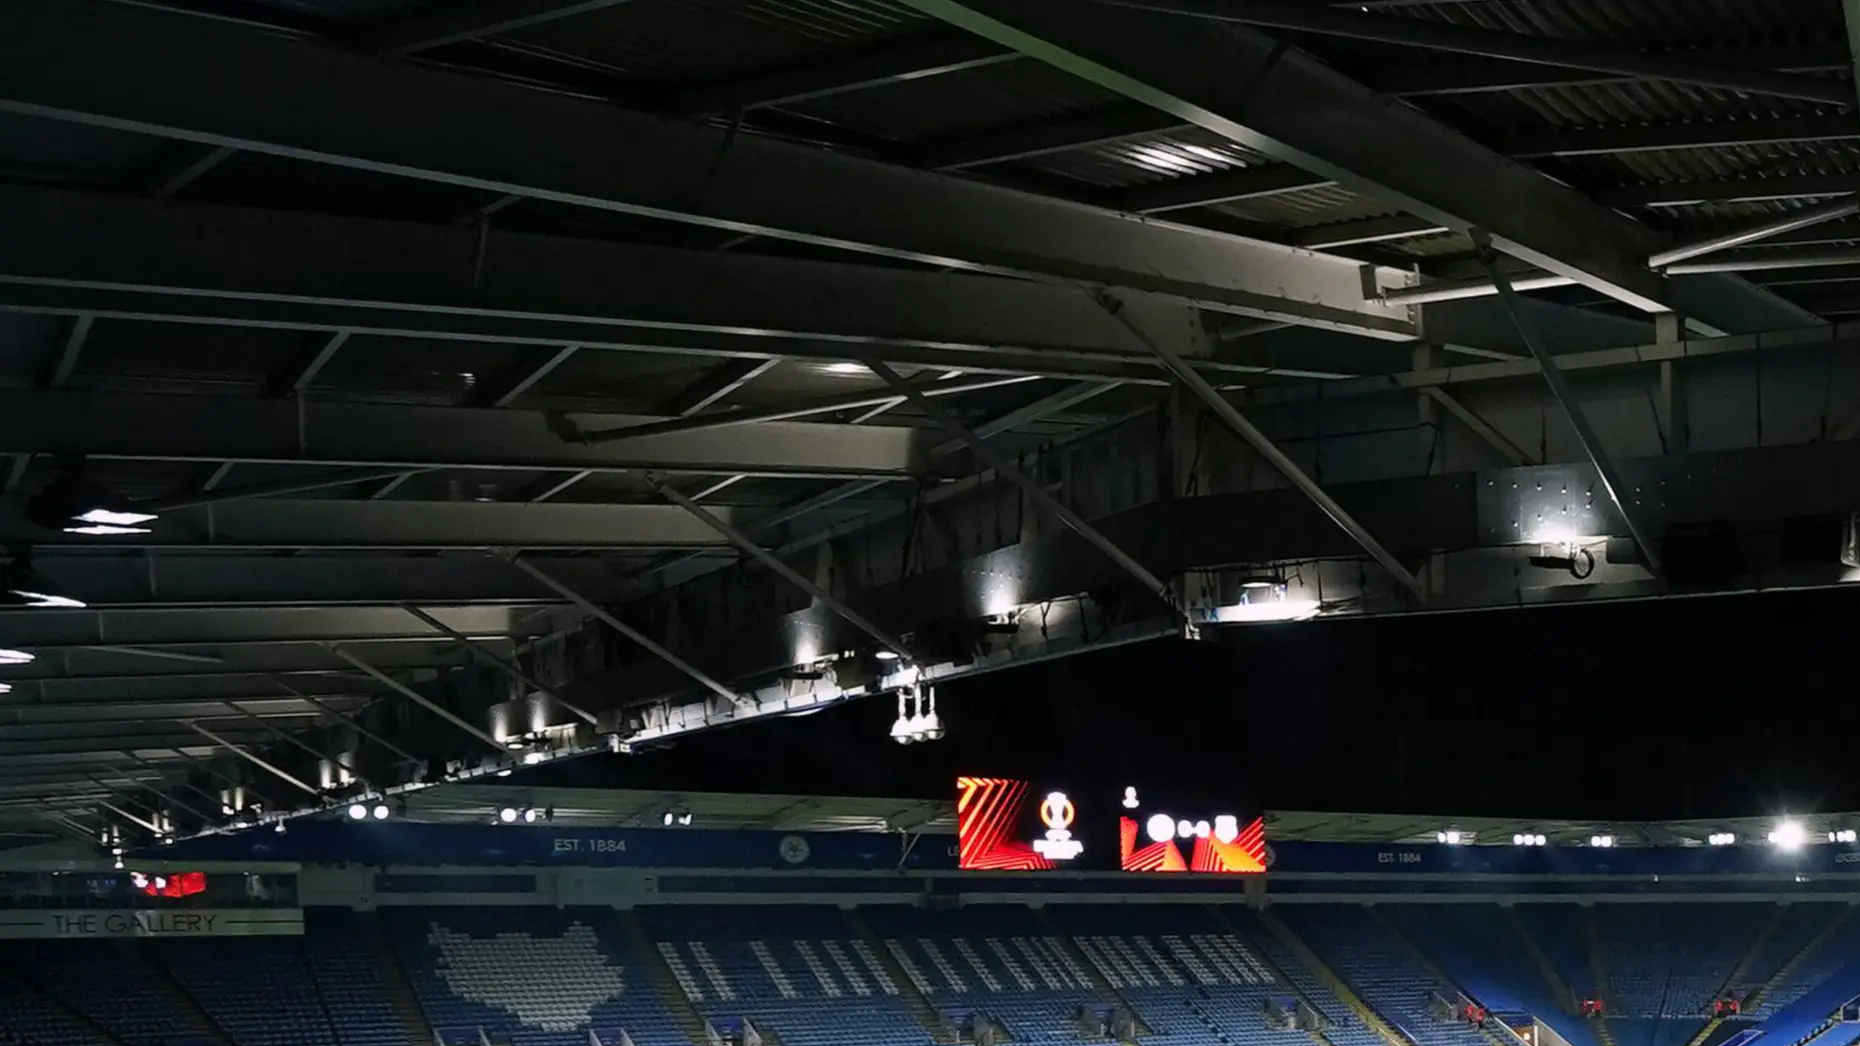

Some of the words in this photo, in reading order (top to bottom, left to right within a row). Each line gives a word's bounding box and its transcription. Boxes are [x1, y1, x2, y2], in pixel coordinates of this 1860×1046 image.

[554, 839, 585, 852] EST.
[589, 839, 627, 852] 1884
[53, 914, 97, 934] THE
[105, 913, 218, 934] GALLERY
